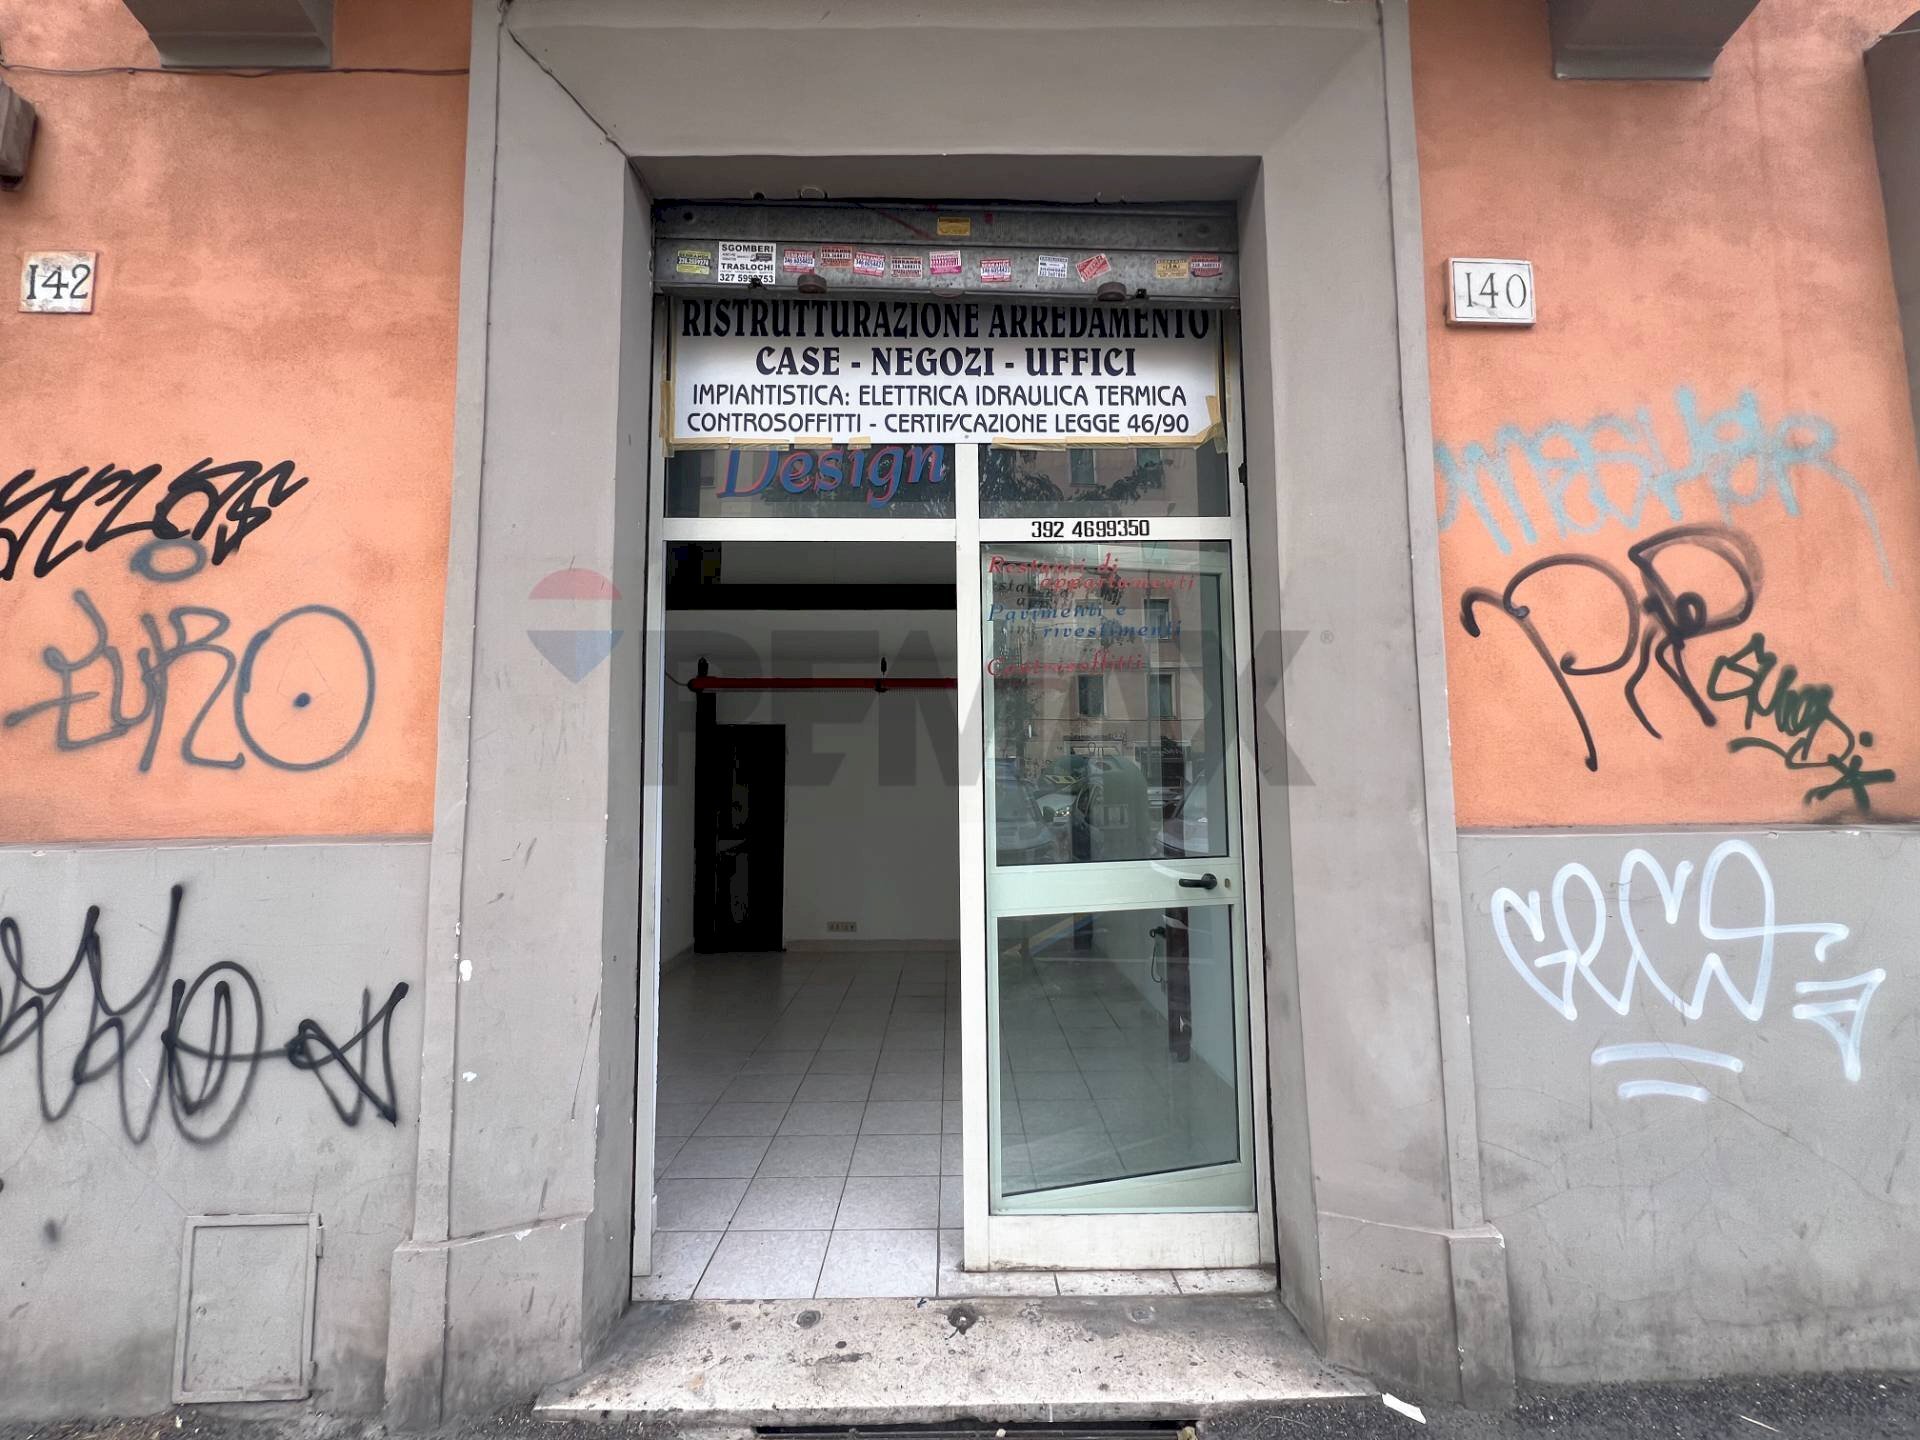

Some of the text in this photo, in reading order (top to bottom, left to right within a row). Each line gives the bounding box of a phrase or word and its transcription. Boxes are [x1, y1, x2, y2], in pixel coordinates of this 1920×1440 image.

[721, 244, 774, 253] SGOMBERI
[719, 274, 735, 282] 327
[720, 263, 774, 271] TRASLOCHI
[26, 263, 91, 300] 142
[1465, 272, 1527, 309] 140
[682, 299, 1209, 340] RISTRUTTURAZIONE ARREDAMENTO
[756, 346, 840, 376] CASE
[871, 346, 995, 377] NEGOZI
[1025, 347, 1137, 377] UFFICI
[693, 383, 1187, 407] IMPIANTISTICA: ELETTRICA IDRAULICA TERMICA
[687, 412, 861, 433] CONTROSOFFITTI
[1055, 413, 1120, 433] LEGGE
[1126, 413, 1190, 435] 46/90
[716, 446, 946, 510] Design
[1031, 518, 1150, 539] 392 4699350
[987, 602, 1127, 622] Pavimenti e
[1042, 619, 1183, 638] rivestimenti
